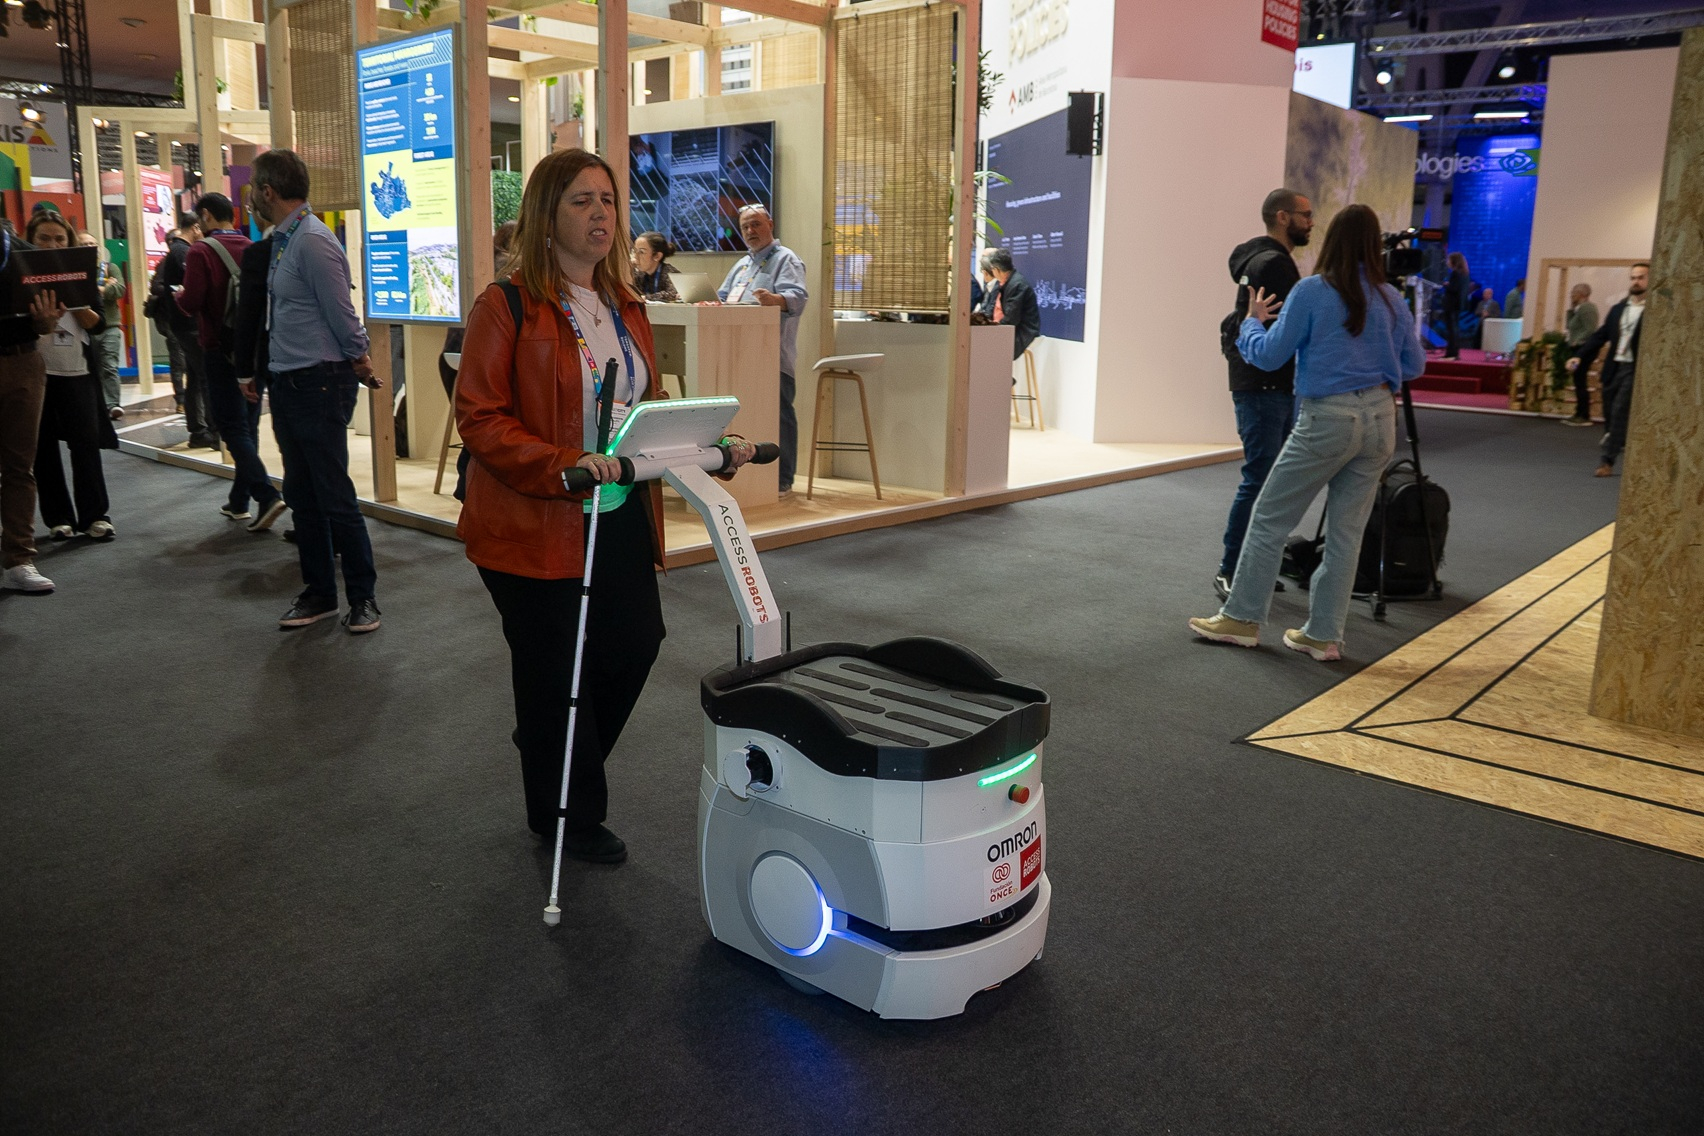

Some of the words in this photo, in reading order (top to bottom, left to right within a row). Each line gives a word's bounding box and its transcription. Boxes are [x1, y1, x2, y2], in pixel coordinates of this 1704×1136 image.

[1264, 15, 1298, 41] POLICIES
[1295, 58, 1313, 72] is
[1018, 81, 1034, 107] AMB
[0, 124, 24, 144] IS
[987, 821, 1038, 863] OMRON
[1023, 847, 1040, 869] ACCESS
[1023, 856, 1040, 878] ROBOTS
[990, 886, 1013, 903] ONCE
